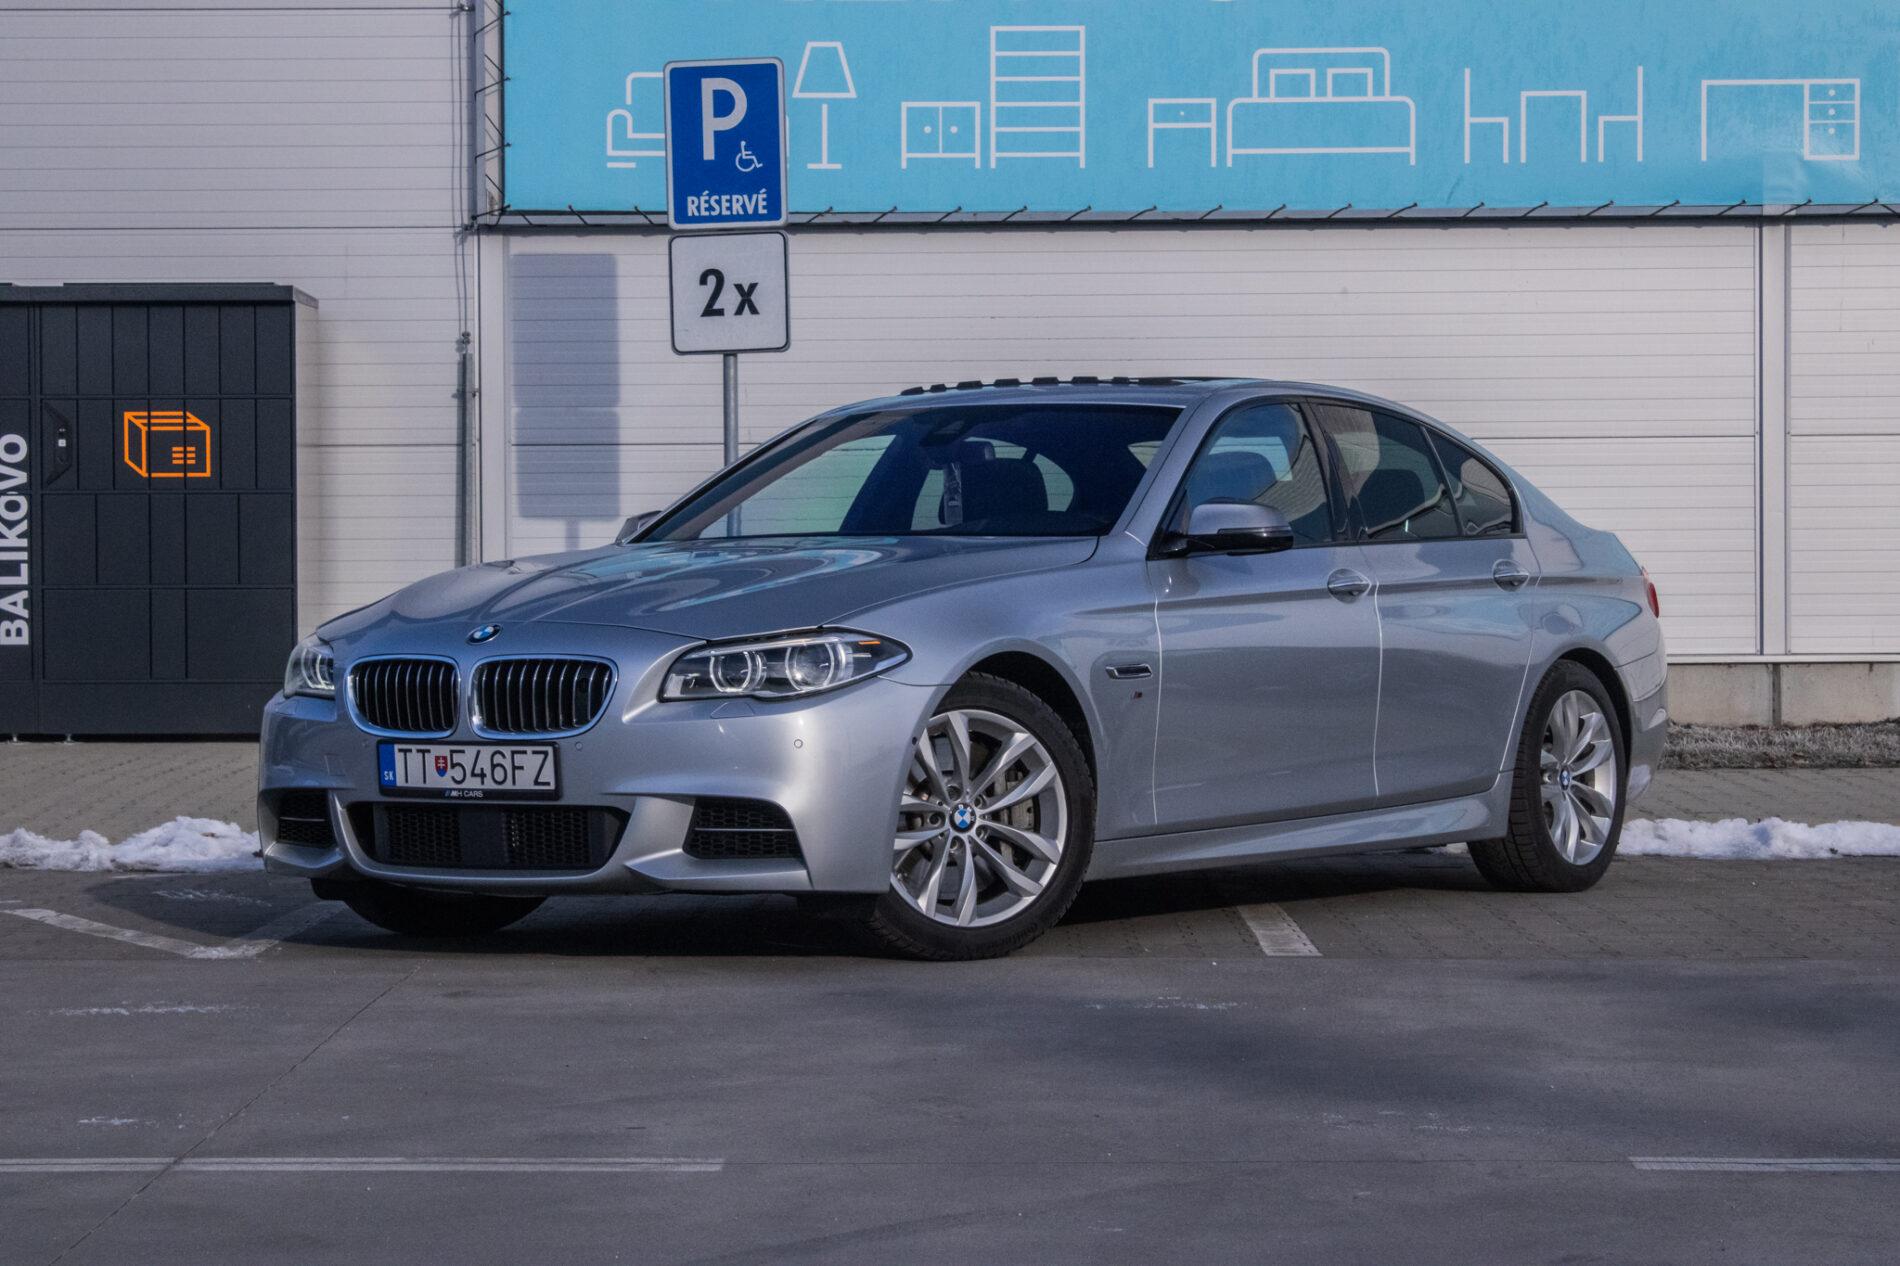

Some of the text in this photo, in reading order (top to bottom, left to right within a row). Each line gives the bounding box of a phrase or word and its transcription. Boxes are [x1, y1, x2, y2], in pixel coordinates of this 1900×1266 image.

[701, 77, 748, 161] P
[687, 188, 768, 217] RÉSERVÉ
[383, 770, 395, 781] SK
[463, 790, 484, 798] CARS
